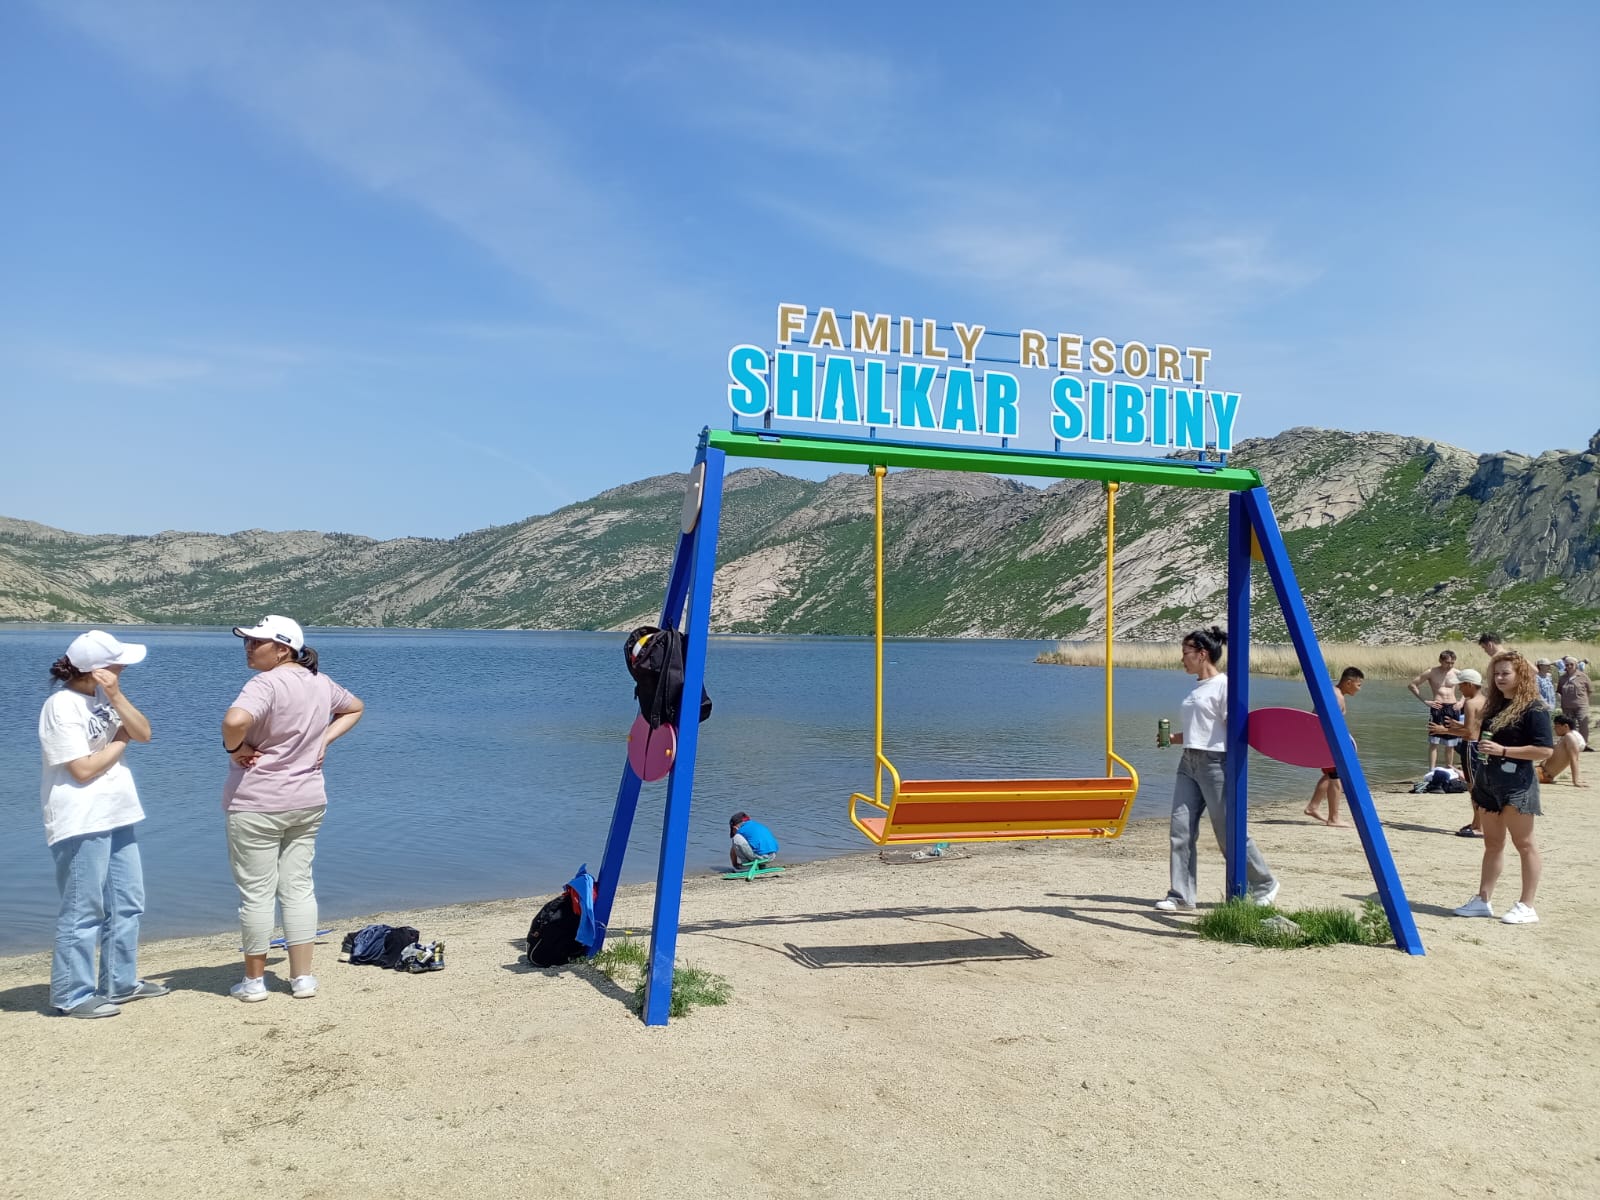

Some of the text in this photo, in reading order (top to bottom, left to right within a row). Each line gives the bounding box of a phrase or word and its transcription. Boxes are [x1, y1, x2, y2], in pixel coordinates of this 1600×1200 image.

[777, 303, 1211, 385] FAMILY RESORT
[728, 344, 1242, 453] SHALKAR SIBINY
